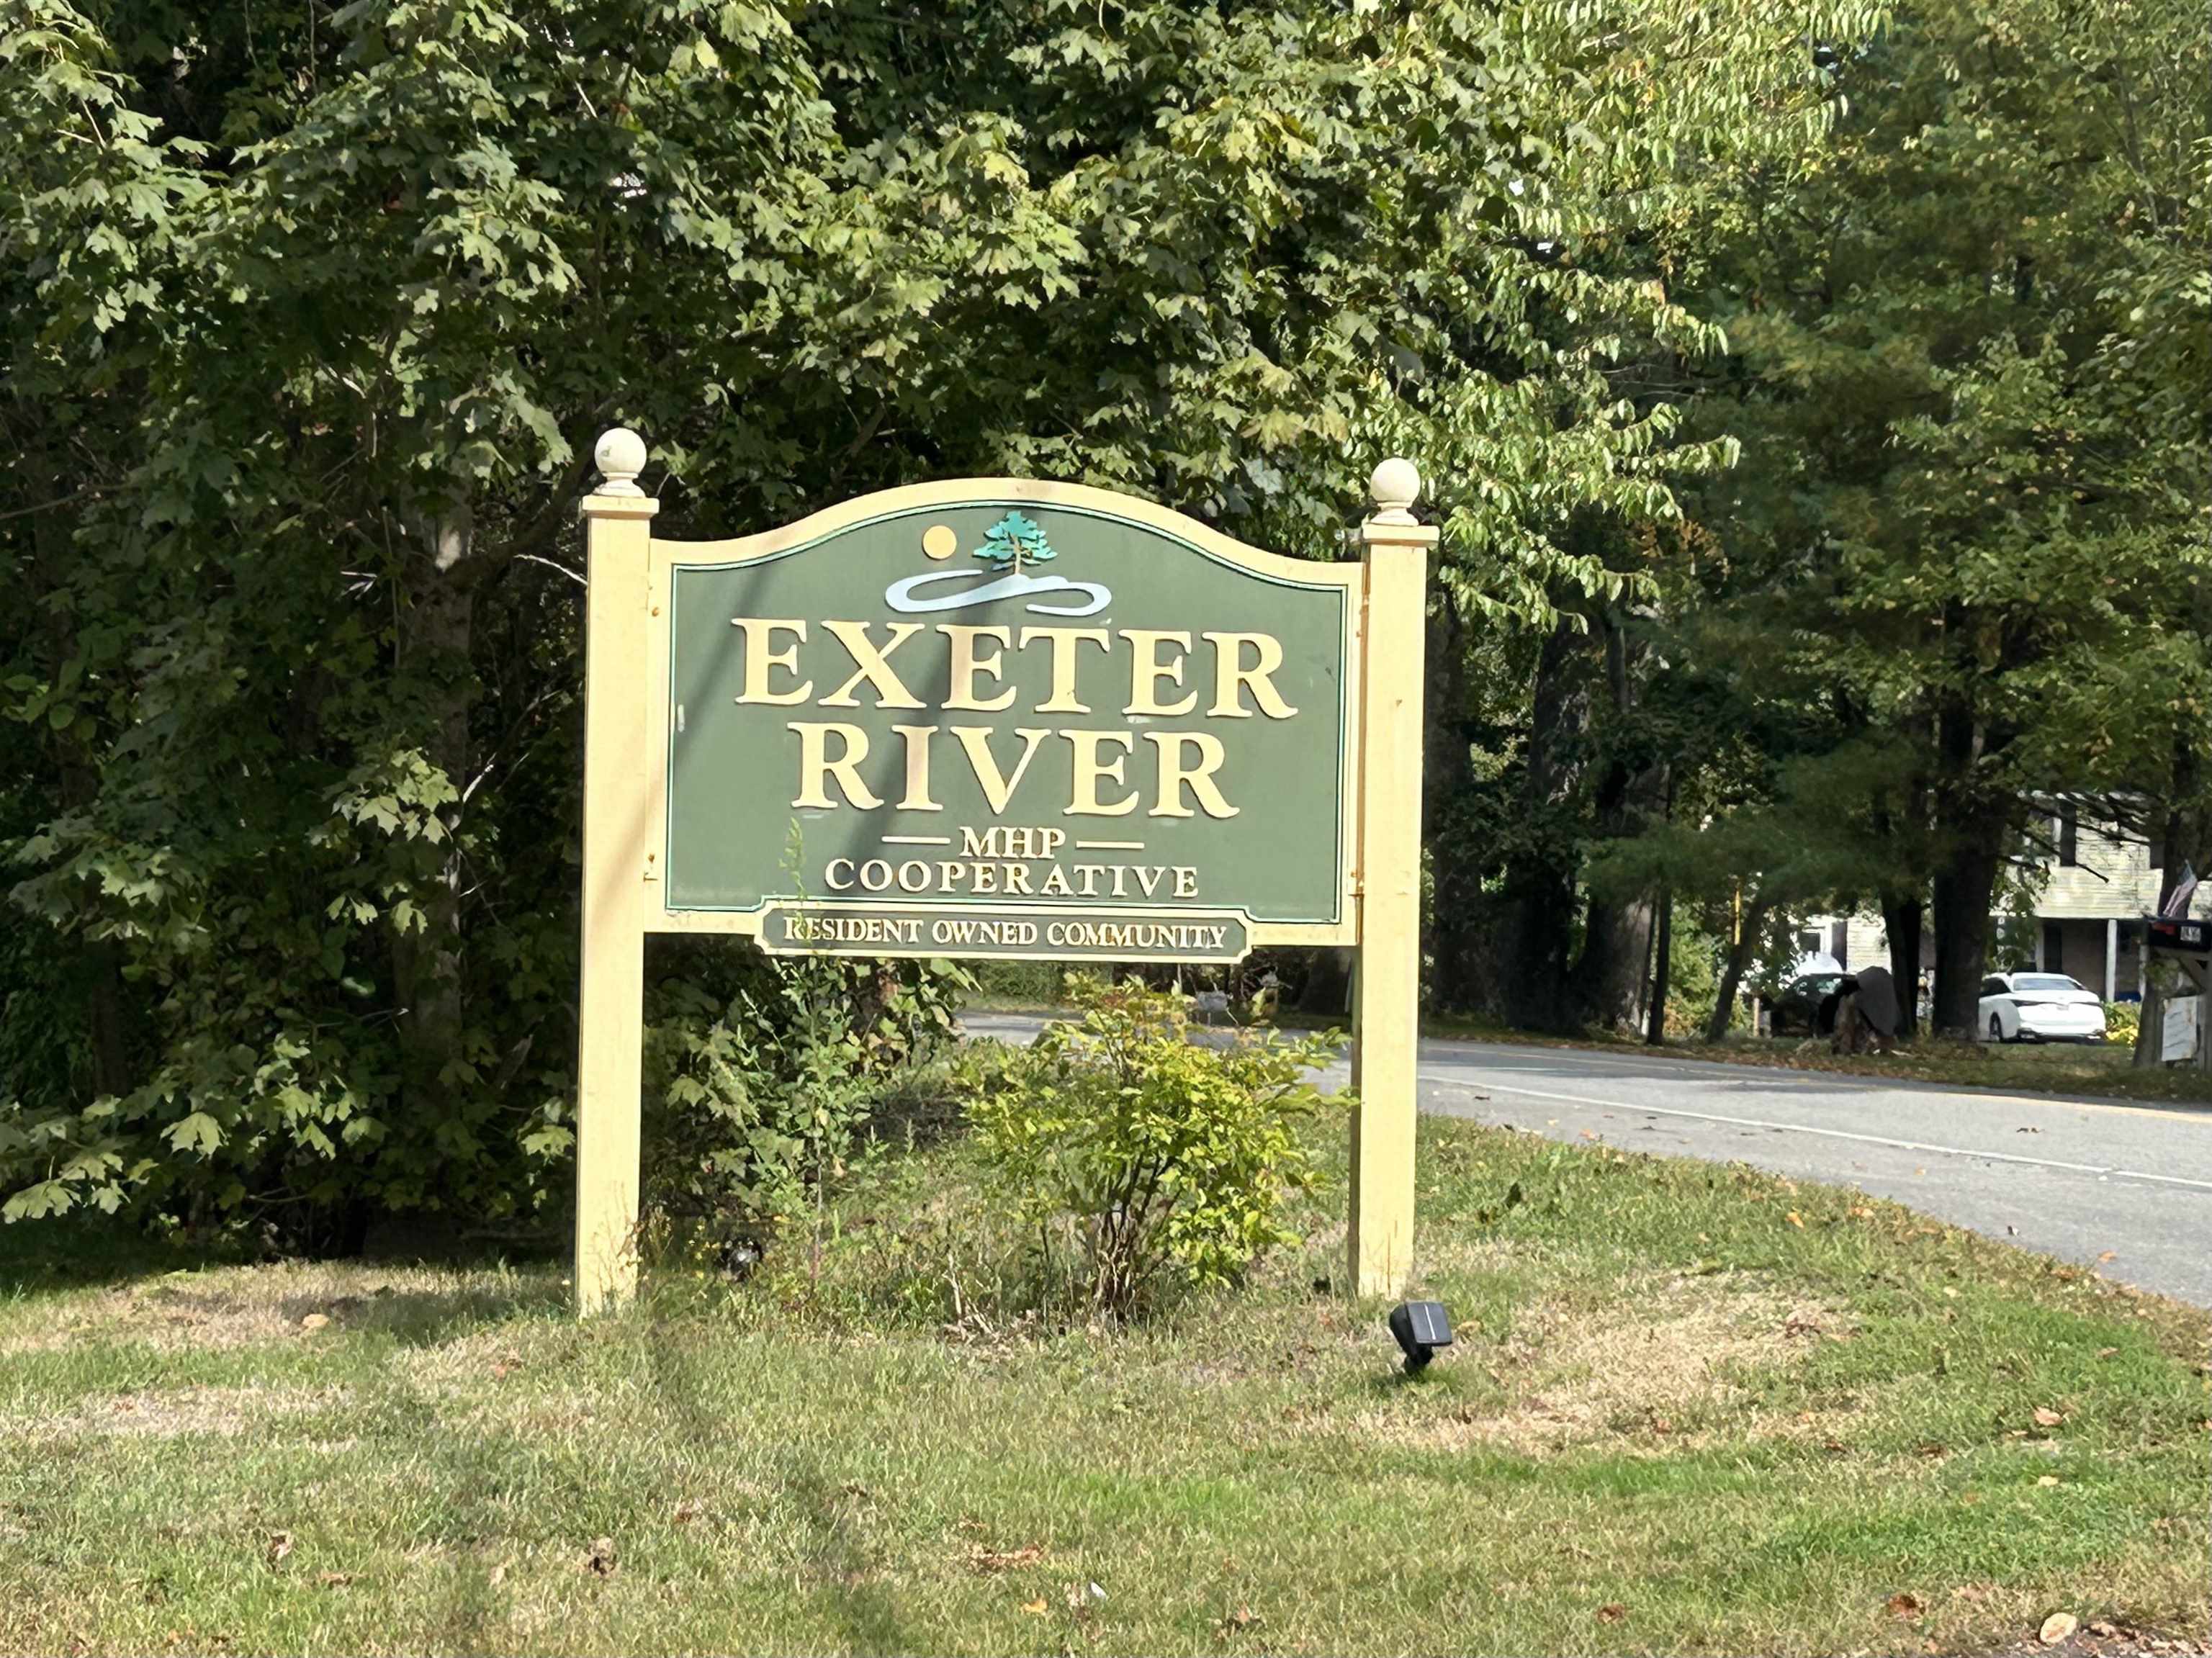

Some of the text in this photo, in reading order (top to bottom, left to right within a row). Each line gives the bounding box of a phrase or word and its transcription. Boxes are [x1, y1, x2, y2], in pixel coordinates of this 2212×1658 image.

[731, 618, 1298, 718] EXETER
[787, 721, 1240, 819] RIVER
[959, 826, 1066, 860] MHP
[824, 859, 1199, 898] COOPERATIVE
[783, 916, 1227, 949] RESIDENT OWNED COMMUNITY
